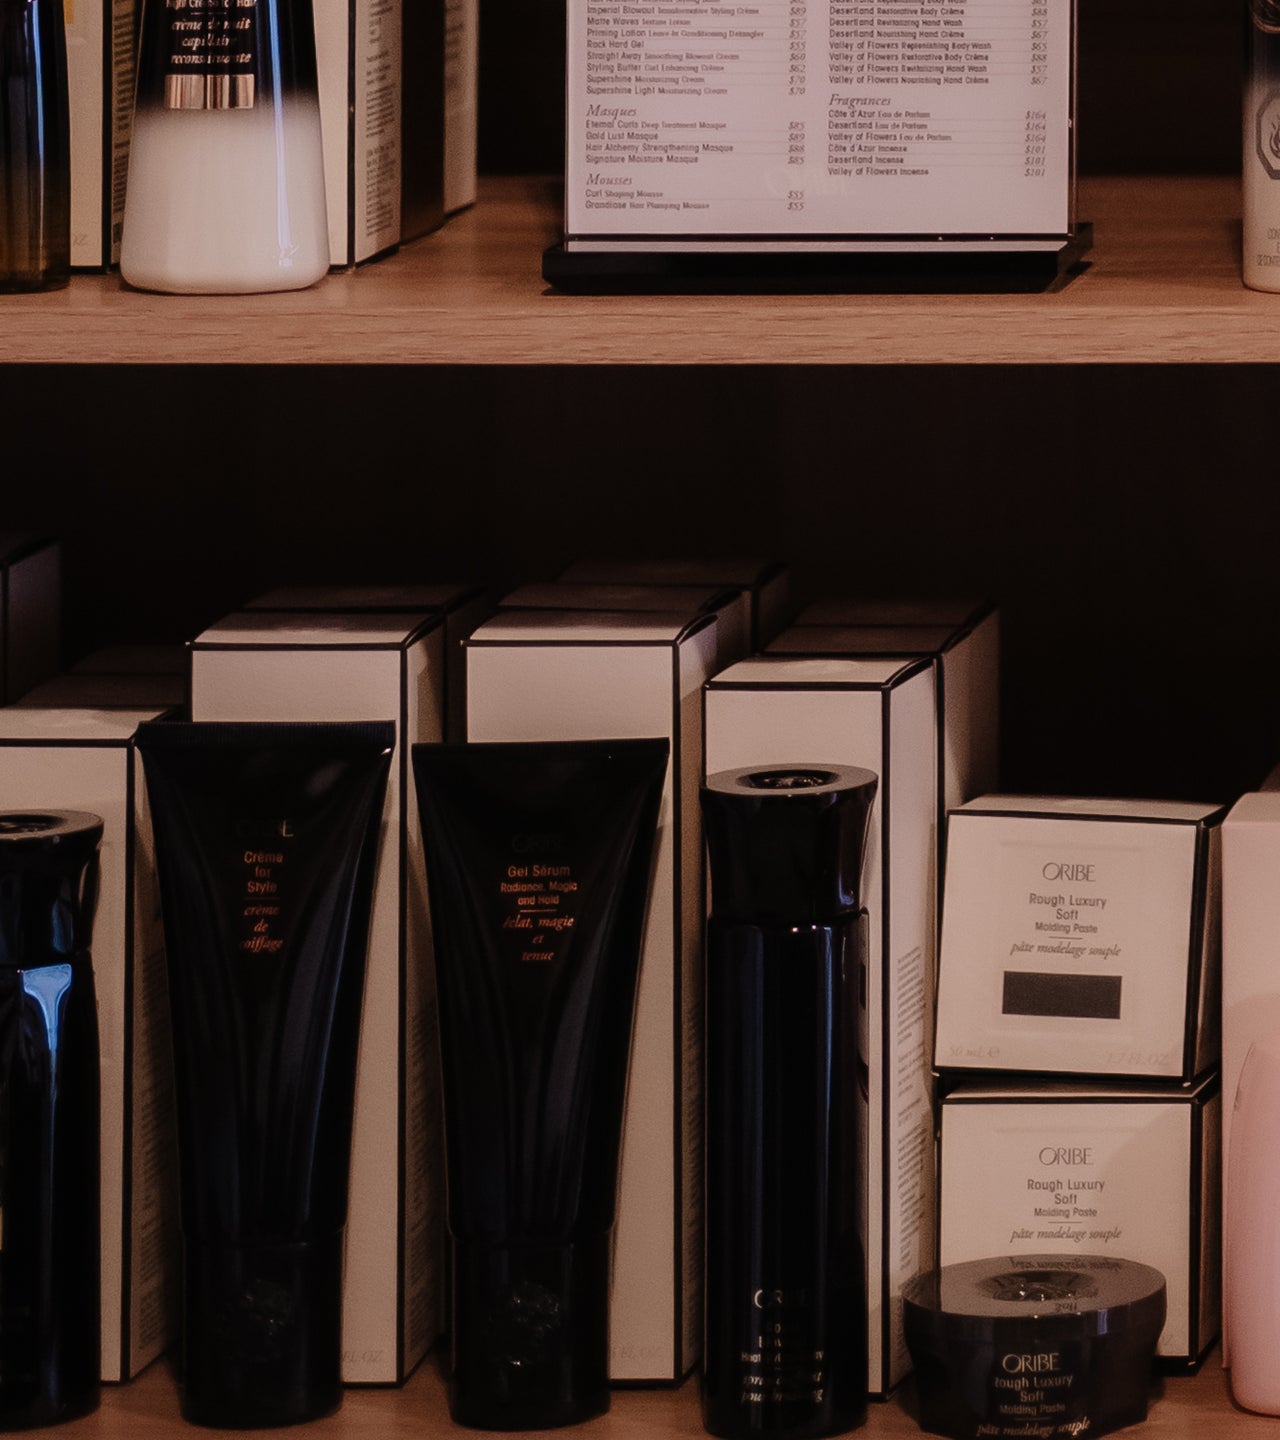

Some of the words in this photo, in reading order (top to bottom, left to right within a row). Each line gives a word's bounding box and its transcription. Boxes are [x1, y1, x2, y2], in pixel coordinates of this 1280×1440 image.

[828, 93, 893, 110] Fragrances
[586, 104, 638, 121] Masques
[586, 173, 634, 187] Mousses
[507, 865, 529, 878] Gel
[532, 864, 571, 878] Sérum
[1042, 862, 1098, 882] ORIBE
[247, 880, 278, 894] Style
[1029, 893, 1066, 907] Rough
[1069, 894, 1108, 910] Luxury
[1055, 908, 1079, 921] Soft
[1034, 921, 1071, 935] Molding
[1073, 923, 1099, 934] Paste
[1009, 941, 1035, 957] pâte
[1036, 941, 1087, 959] modelage
[1087, 944, 1123, 960] souple
[1038, 1146, 1095, 1167] ORIBE
[1027, 1179, 1064, 1193] Rough
[1067, 1179, 1106, 1193] Luxury
[1001, 1352, 1061, 1374] ORIBE
